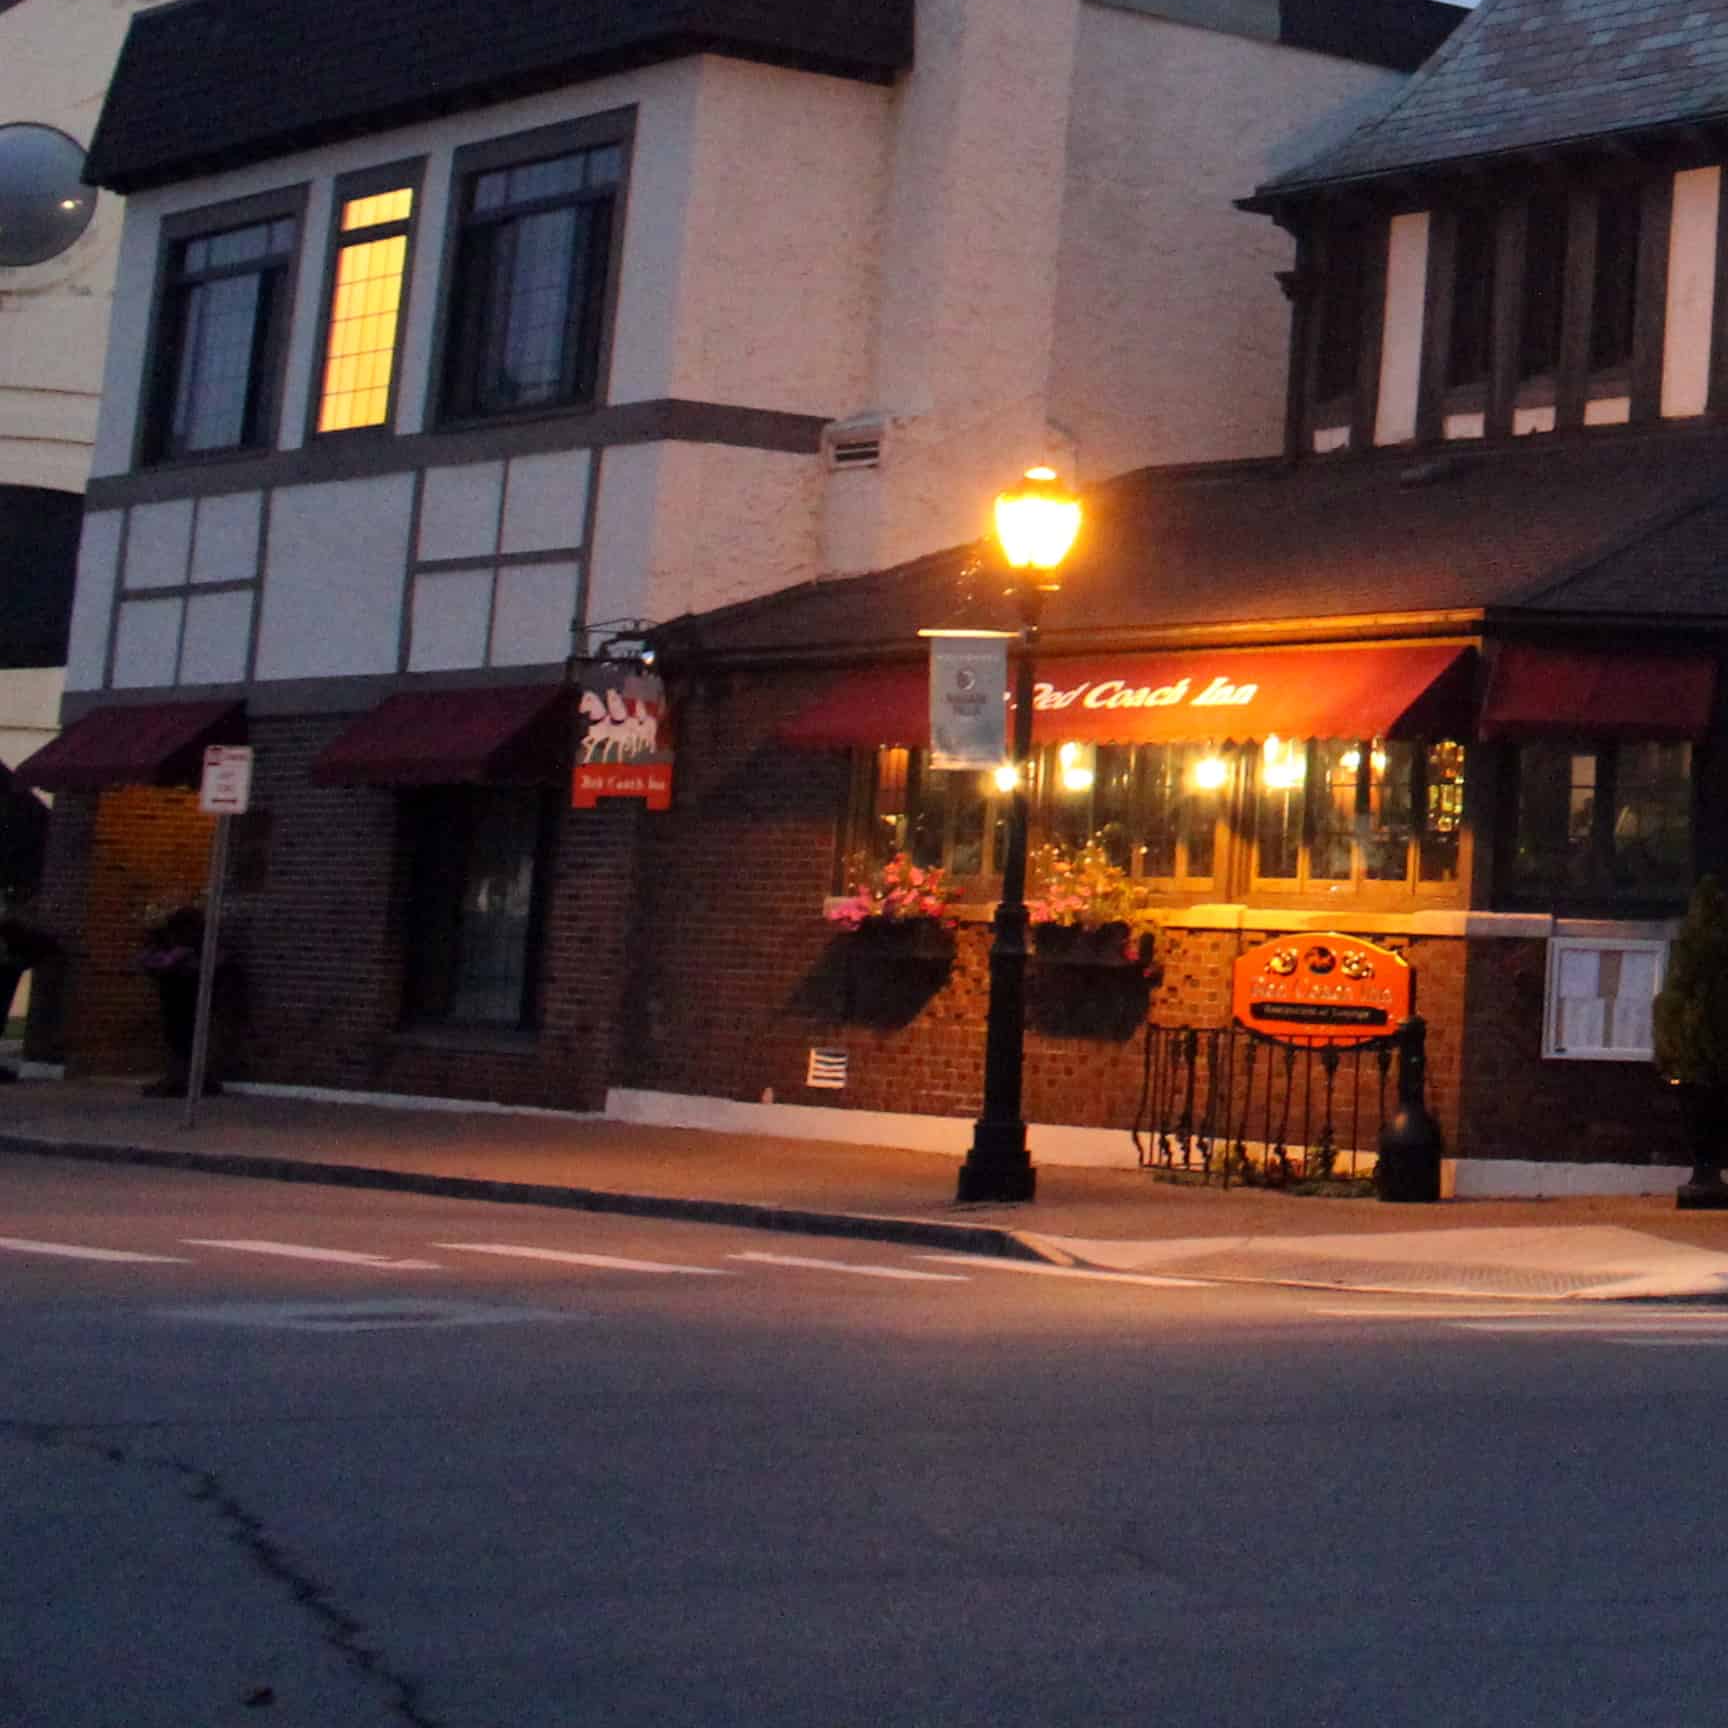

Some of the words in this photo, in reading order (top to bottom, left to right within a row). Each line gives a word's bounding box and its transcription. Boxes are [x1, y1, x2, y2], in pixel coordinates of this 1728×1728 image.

[1033, 681, 1091, 710] Red
[1083, 678, 1192, 709] Coach
[1190, 676, 1260, 707] Inn
